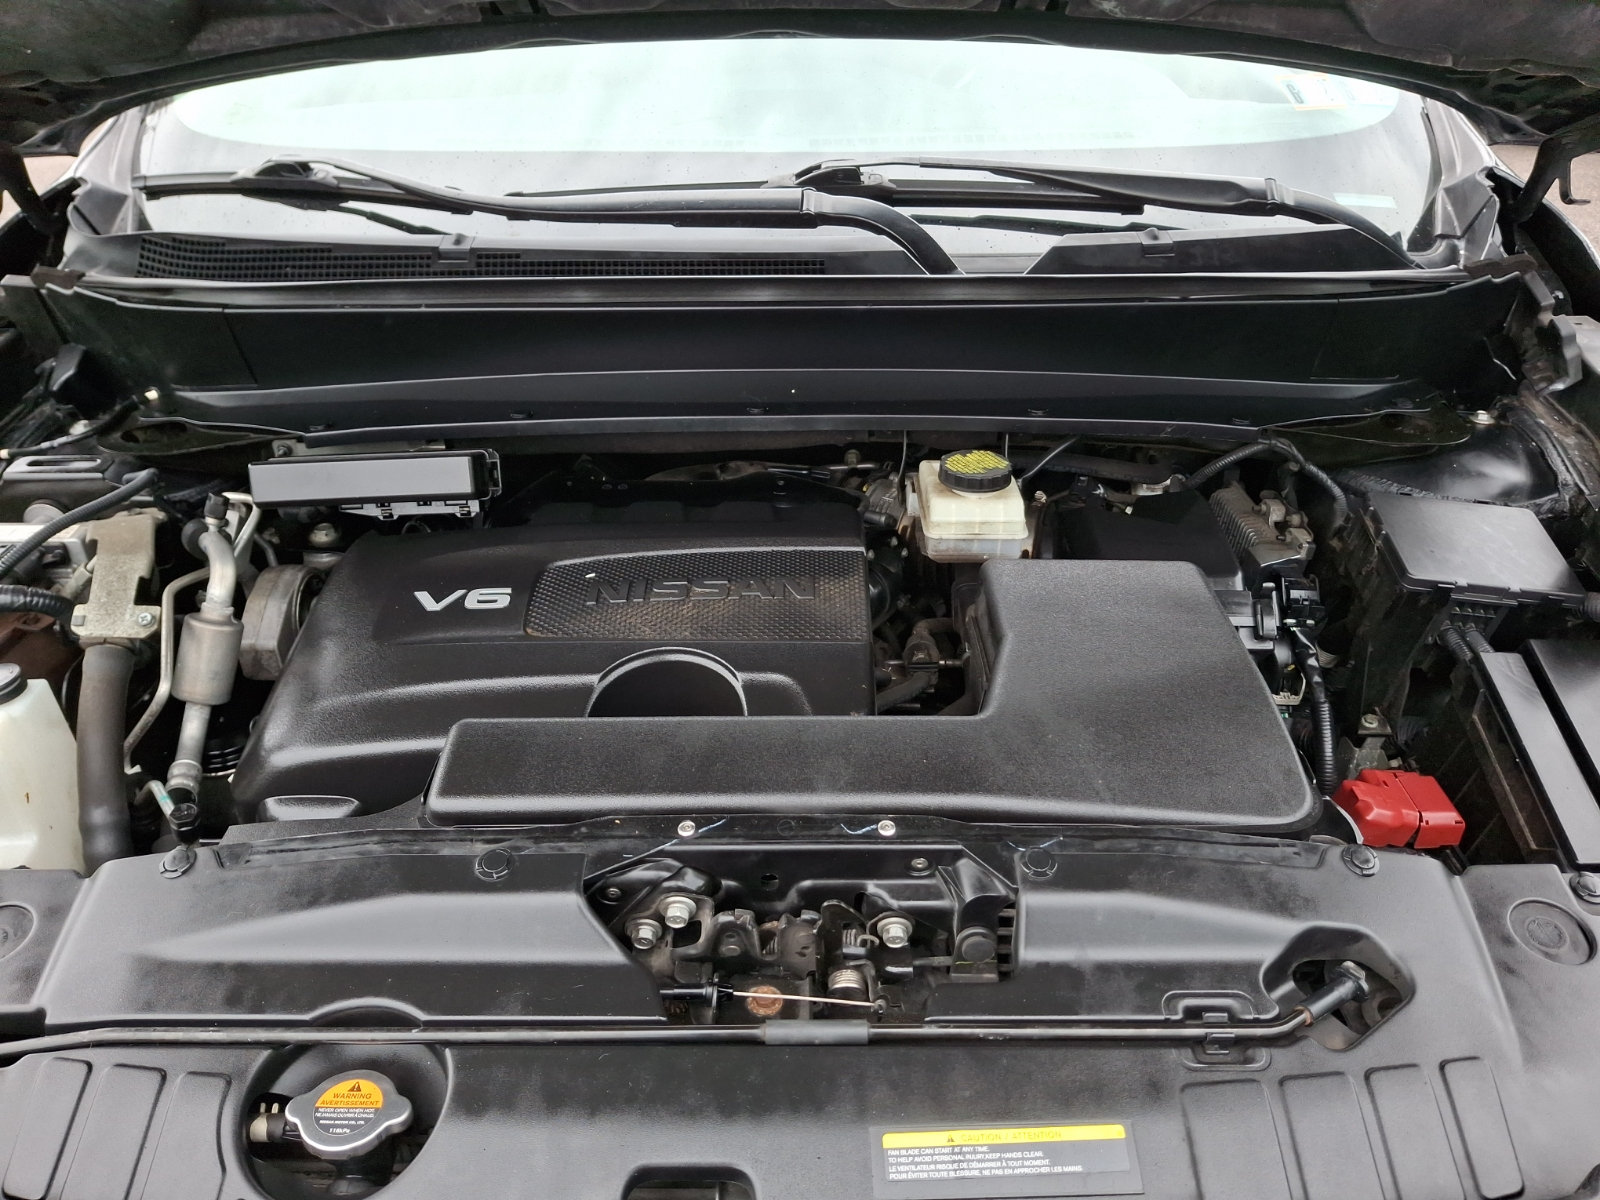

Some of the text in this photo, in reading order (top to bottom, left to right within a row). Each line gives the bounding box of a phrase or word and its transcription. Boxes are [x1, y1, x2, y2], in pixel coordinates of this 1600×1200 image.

[585, 576, 815, 605] NISSAN
[413, 587, 512, 612] V6
[961, 1133, 1002, 1143] CAUTION
[1011, 1130, 1062, 1142] ATTENTION
[897, 1163, 936, 1172] VENTILATEUR
[968, 1160, 1001, 1168] DÉMARRER
[907, 1171, 928, 1179] ÉVITER
